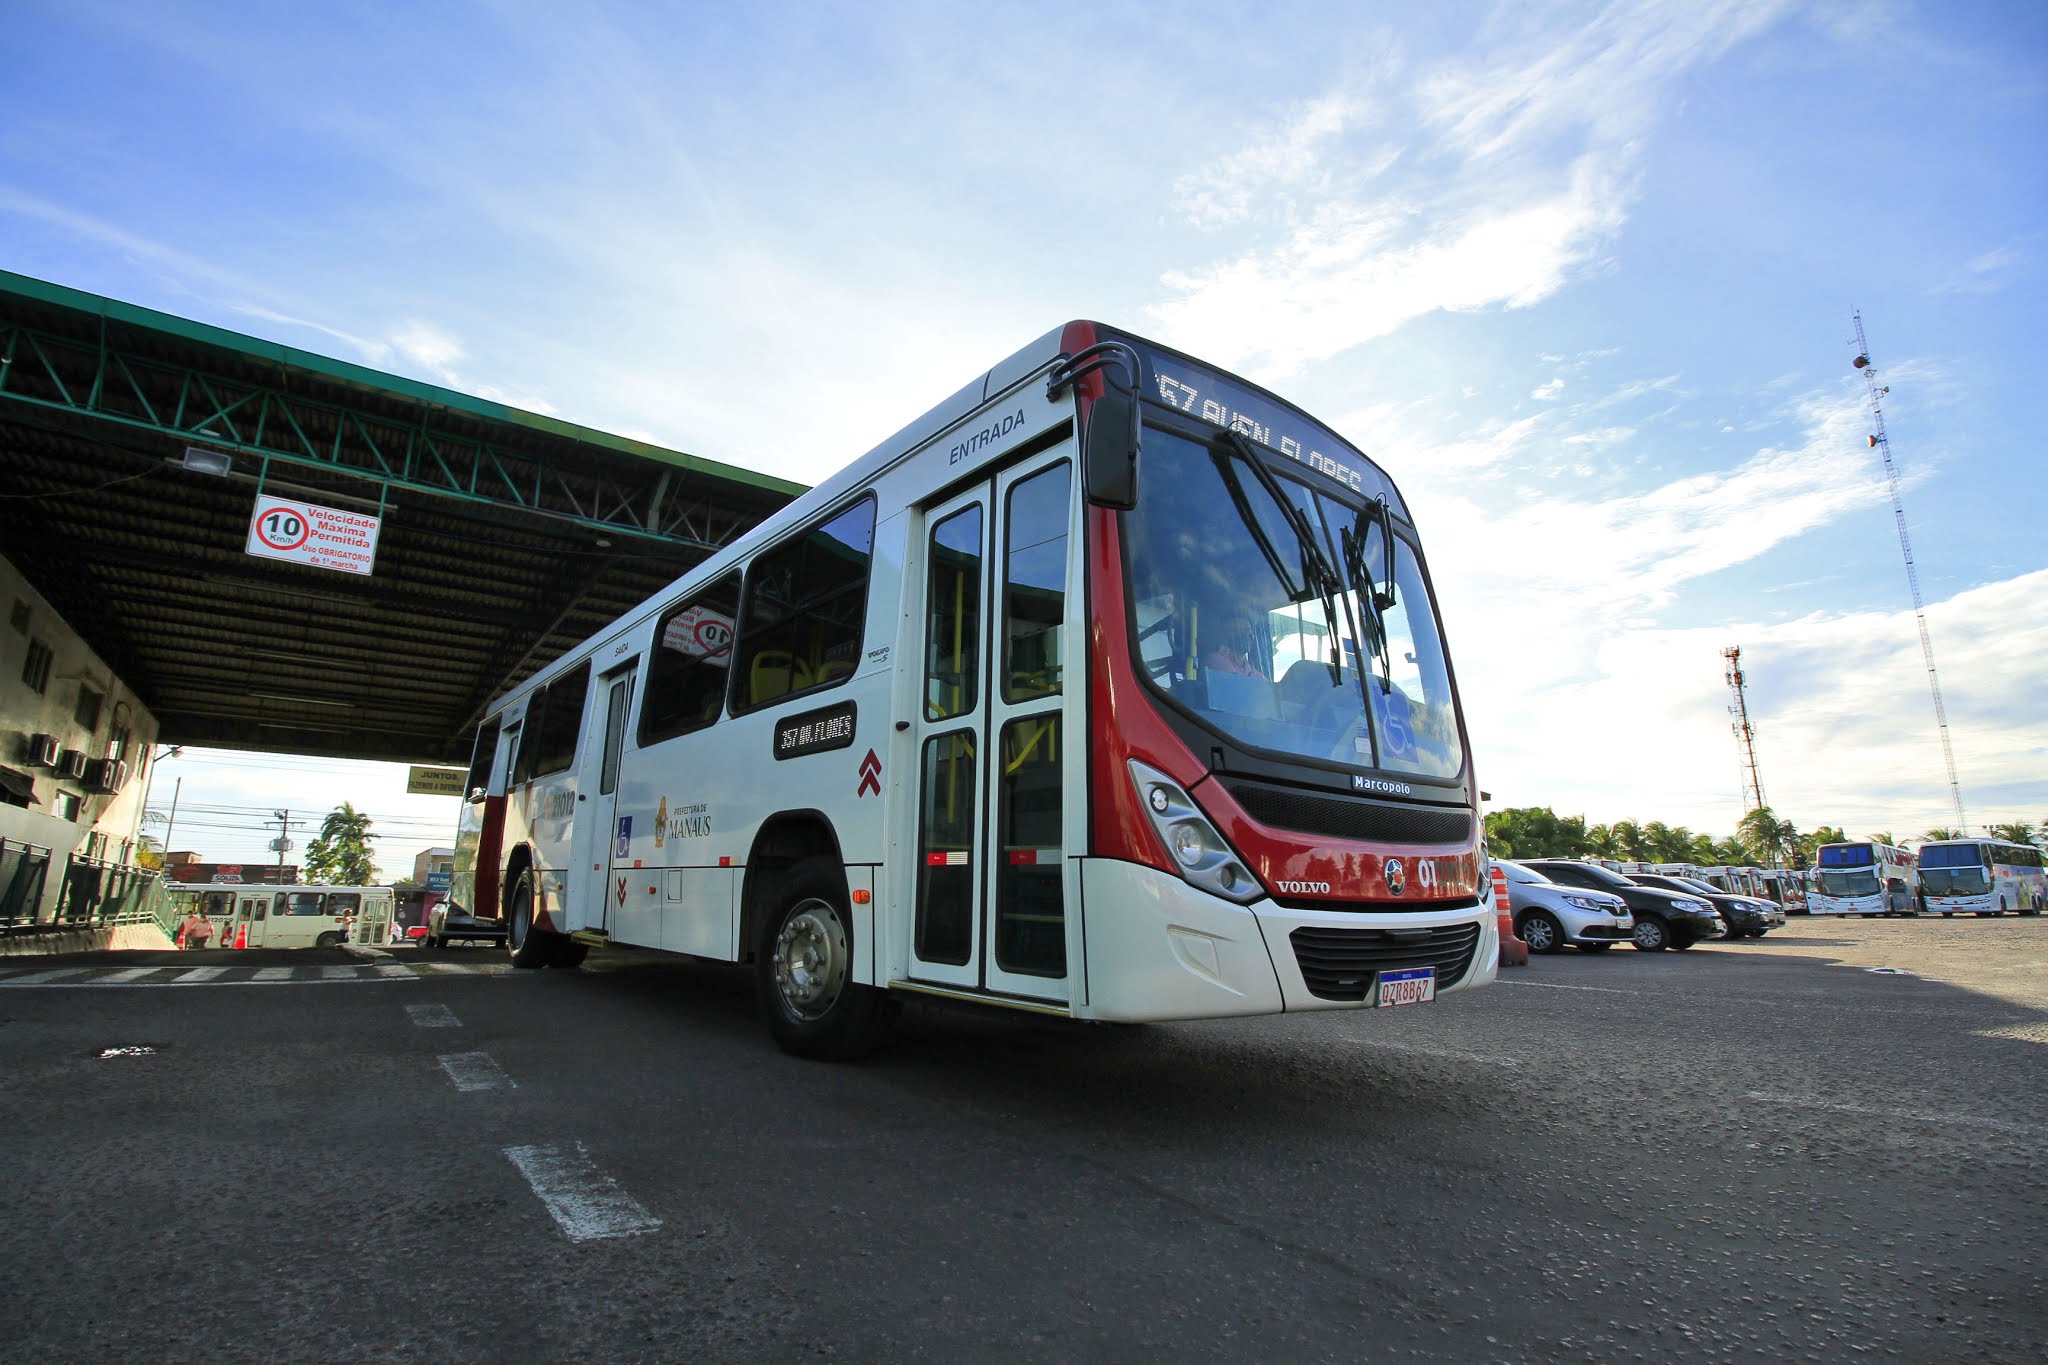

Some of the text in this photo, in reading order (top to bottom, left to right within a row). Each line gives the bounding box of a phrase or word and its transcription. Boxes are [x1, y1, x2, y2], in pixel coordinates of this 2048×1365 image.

[949, 409, 1025, 465] ENTRADA
[267, 514, 301, 536] 10
[308, 508, 376, 529] Velocidade
[317, 520, 367, 537] Máxima
[270, 533, 294, 544] Km/h
[310, 529, 370, 548] Permitida
[302, 544, 317, 553] Uso
[330, 560, 358, 570] marcha
[781, 728, 798, 749] 357
[1355, 775, 1410, 794] Marcopolo
[673, 803, 707, 815] PREFEITURA DE
[668, 815, 711, 839] MANAUS
[214, 873, 240, 881] SOUZA
[1275, 881, 1331, 894] VOLVO
[1382, 980, 1428, 1003] QZR8B67
